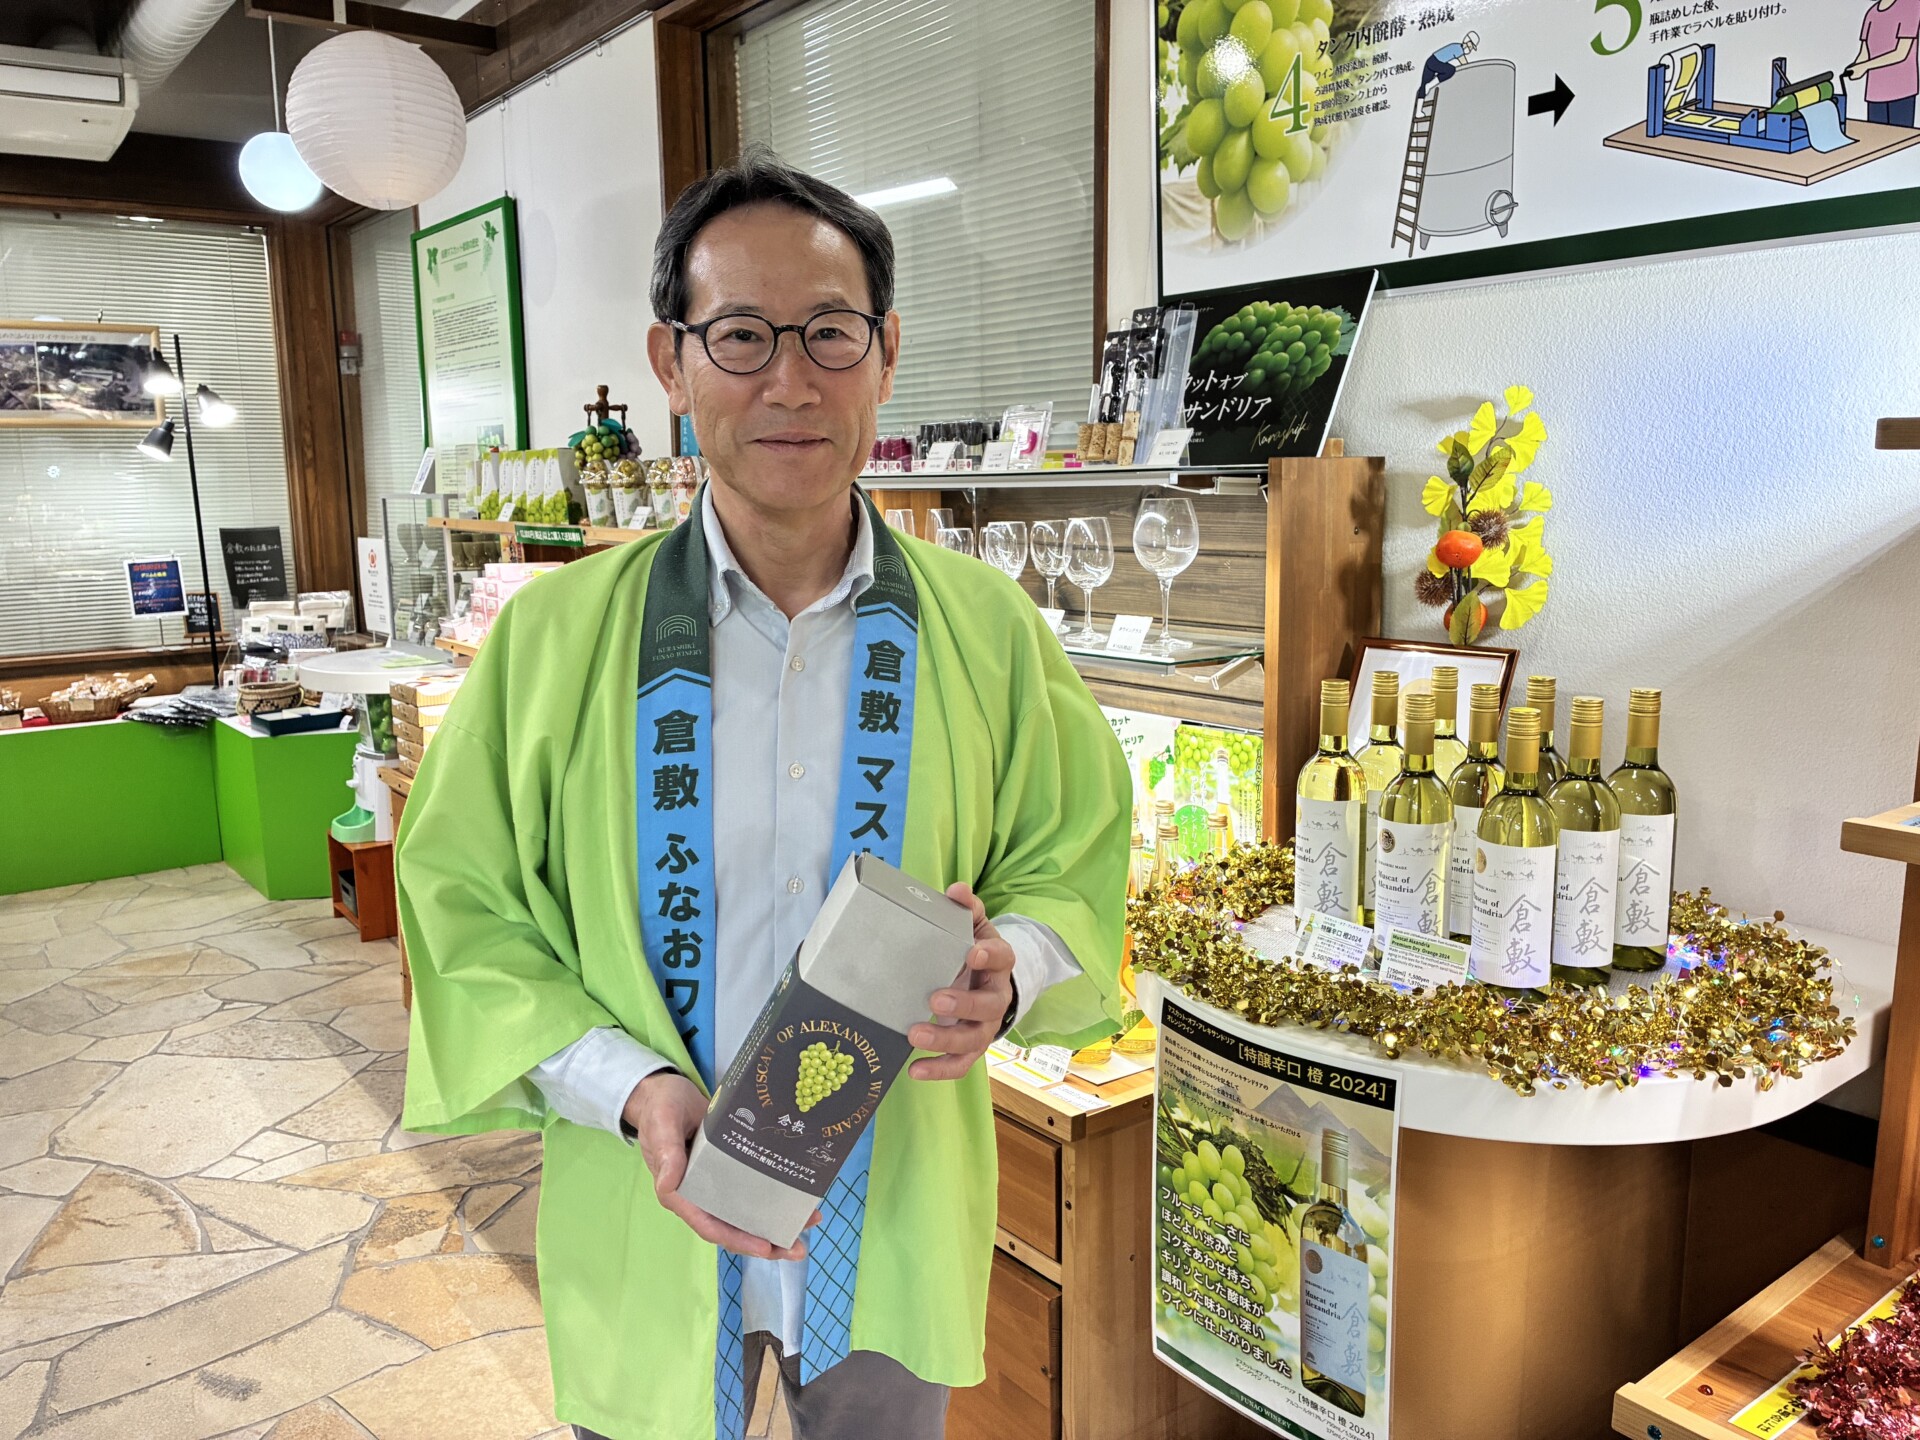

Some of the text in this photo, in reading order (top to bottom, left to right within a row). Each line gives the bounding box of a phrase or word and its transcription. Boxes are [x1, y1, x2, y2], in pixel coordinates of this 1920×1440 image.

[1590, 0, 1643, 56] 5
[1649, 0, 1719, 26] 瓶詰めした後、
[1649, 3, 1788, 44] 手作業でラベルを貼り付け。
[1270, 52, 1310, 136] 4
[652, 709, 700, 811] 倉敷
[849, 639, 905, 862] 倉敷 マス
[1313, 841, 1349, 914] 倉敷
[1401, 876, 1411, 884] of
[1490, 900, 1500, 908] of
[1622, 858, 1660, 935] 倉敷
[1392, 934, 1408, 942] Muscat
[1502, 893, 1542, 975] 倉敷
[1571, 876, 1609, 955] 倉敷
[1391, 940, 1411, 949] Premium
[1421, 948, 1438, 957] Orange
[1166, 1004, 1236, 1047] マスカット・オブ・アレキサンドリア
[1166, 1016, 1195, 1035] オレンジワイン
[756, 1044, 775, 1109] MUSCAT
[776, 1024, 796, 1043] OF
[800, 1020, 883, 1074] ALEXANDRIA
[1307, 1066, 1324, 1086] 橙
[1330, 1072, 1387, 1101] 2024]
[722, 1133, 816, 1185] ワインを贅沢に使用したワインケーキ
[731, 1130, 816, 1176] マスカット・オブ・アレキサンドリア
[1161, 1186, 1251, 1247] フルーティーさに
[1161, 1206, 1239, 1263] ほどよい渋みと
[1161, 1227, 1258, 1295] コクをあわせ持ち、
[1161, 1249, 1265, 1319] キリッとした酸味が
[1161, 1268, 1266, 1341] 調和した味わい深い
[1304, 1289, 1338, 1310] Muscat of
[1304, 1298, 1341, 1321] Alexandria
[1161, 1289, 1293, 1379] ワインに仕上がりました
[1341, 1302, 1366, 1381] 倉敷
[1240, 1395, 1292, 1429] FUNAO WINERY
